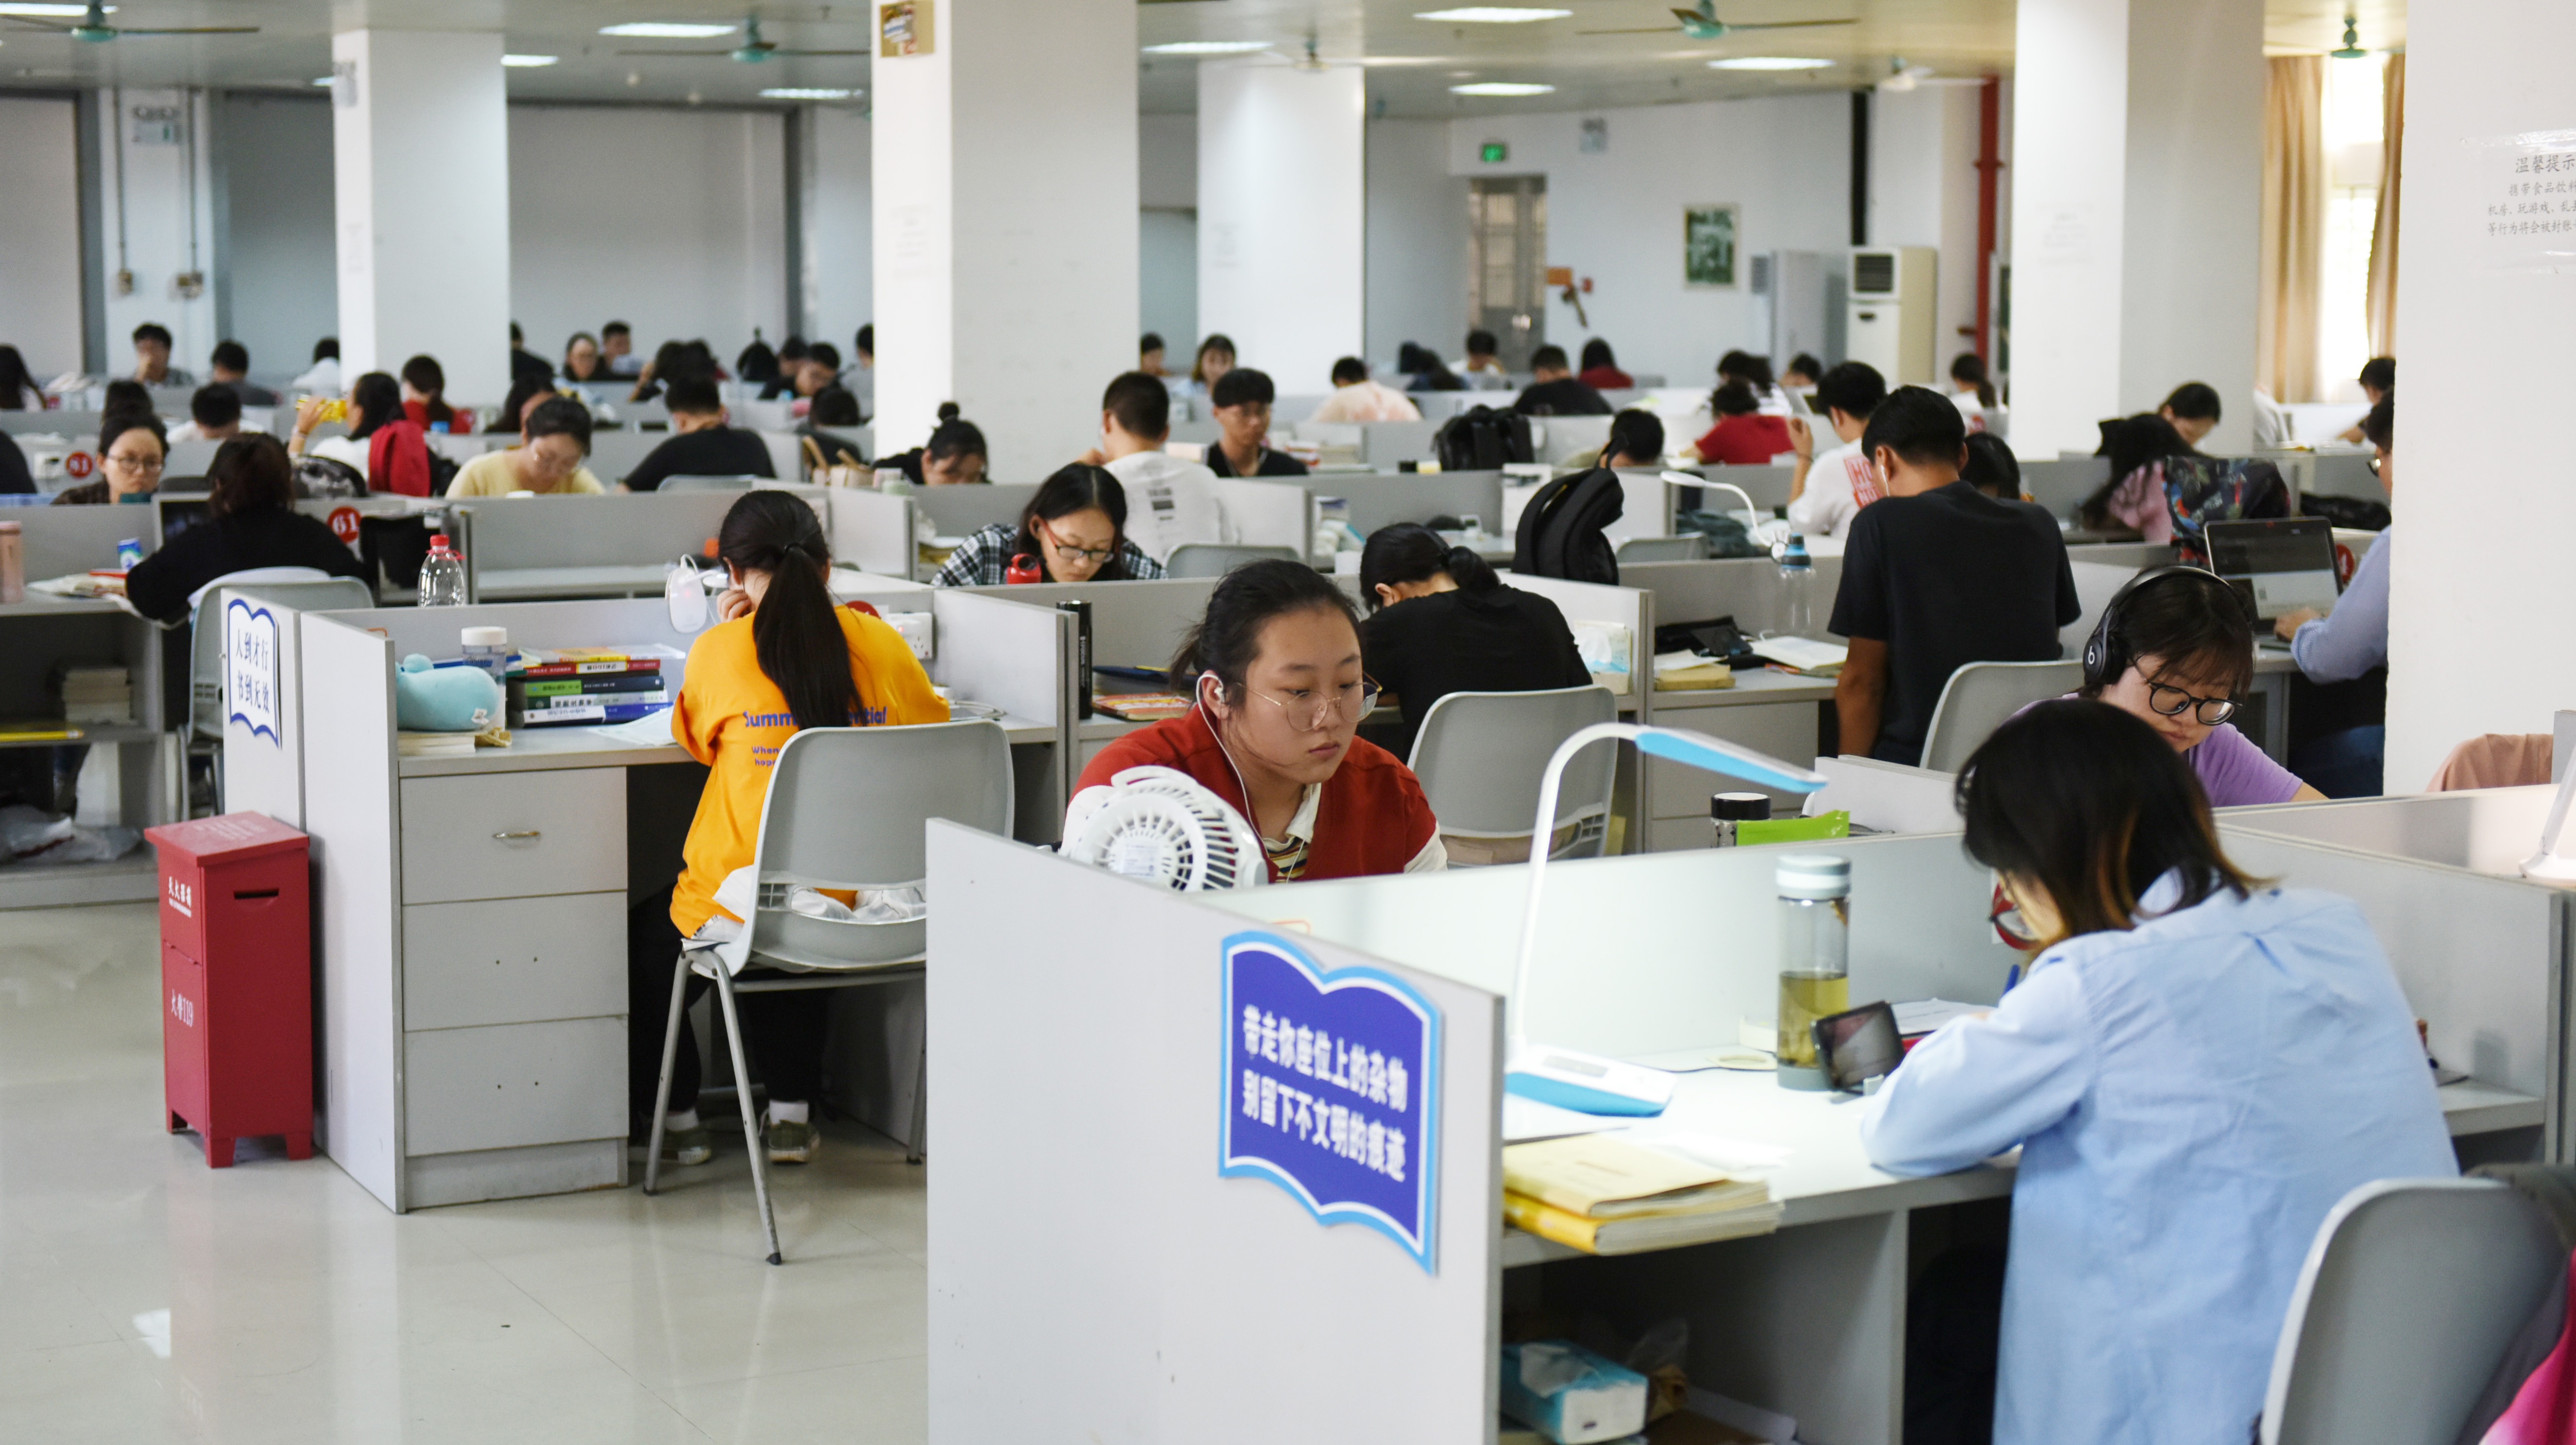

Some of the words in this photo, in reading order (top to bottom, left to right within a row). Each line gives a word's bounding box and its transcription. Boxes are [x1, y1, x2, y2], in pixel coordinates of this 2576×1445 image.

[2515, 154, 2576, 173] 温馨提示
[2488, 219, 2576, 237] 等行为将会被封账
[332, 513, 359, 535] 61
[236, 628, 268, 672] 人到才行
[742, 710, 797, 727] Summ
[171, 988, 193, 1027] 火警119
[1243, 1003, 1408, 1113] 带走你座位上的杂物
